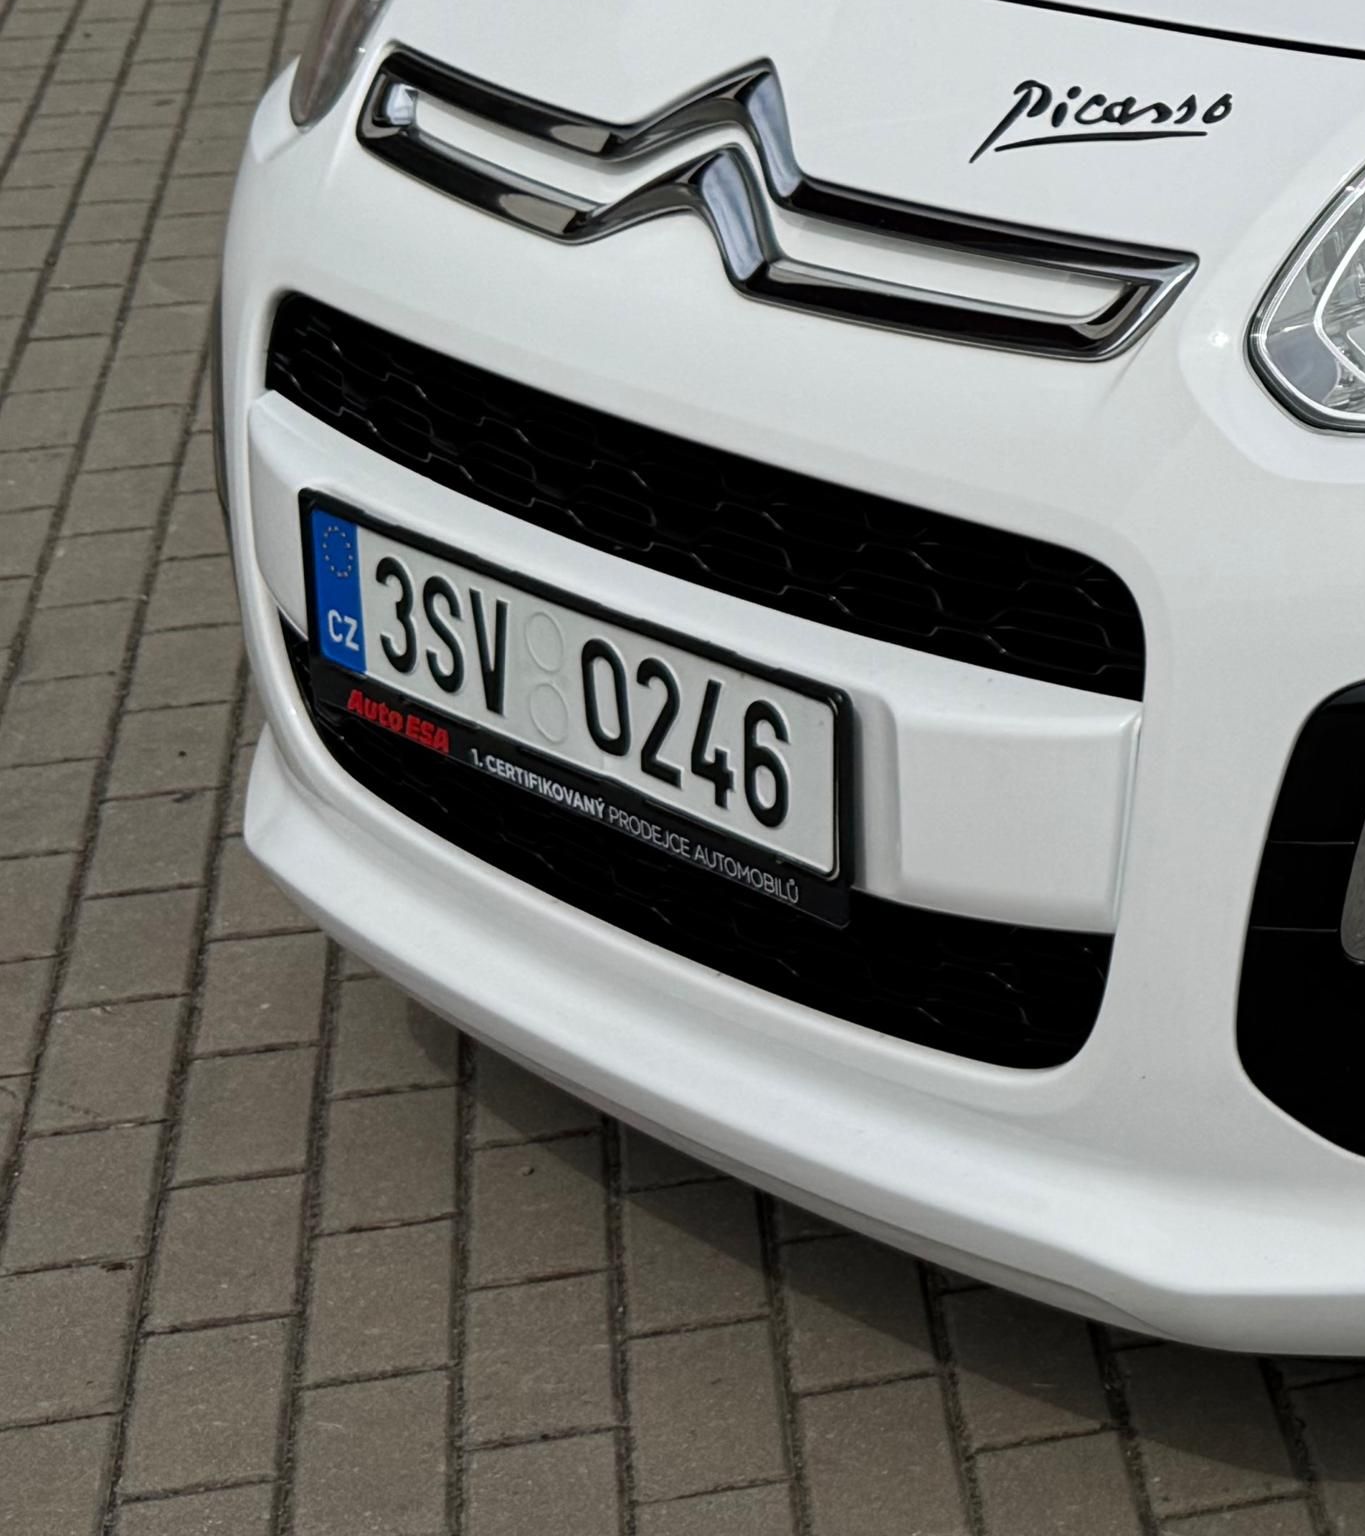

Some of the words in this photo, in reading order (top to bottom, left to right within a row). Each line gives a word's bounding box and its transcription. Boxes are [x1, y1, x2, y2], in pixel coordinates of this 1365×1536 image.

[968, 79, 1233, 164] Picasso
[327, 608, 360, 652] CZ
[347, 689, 402, 733] Auto
[405, 712, 450, 754] ESA
[375, 556, 511, 717] 3SV
[581, 637, 792, 830] 0246
[485, 755, 605, 819] CERTIFIKOVANÝ
[608, 805, 691, 859] PRODEJCE
[693, 843, 800, 905] AUTOMOBILŮ
